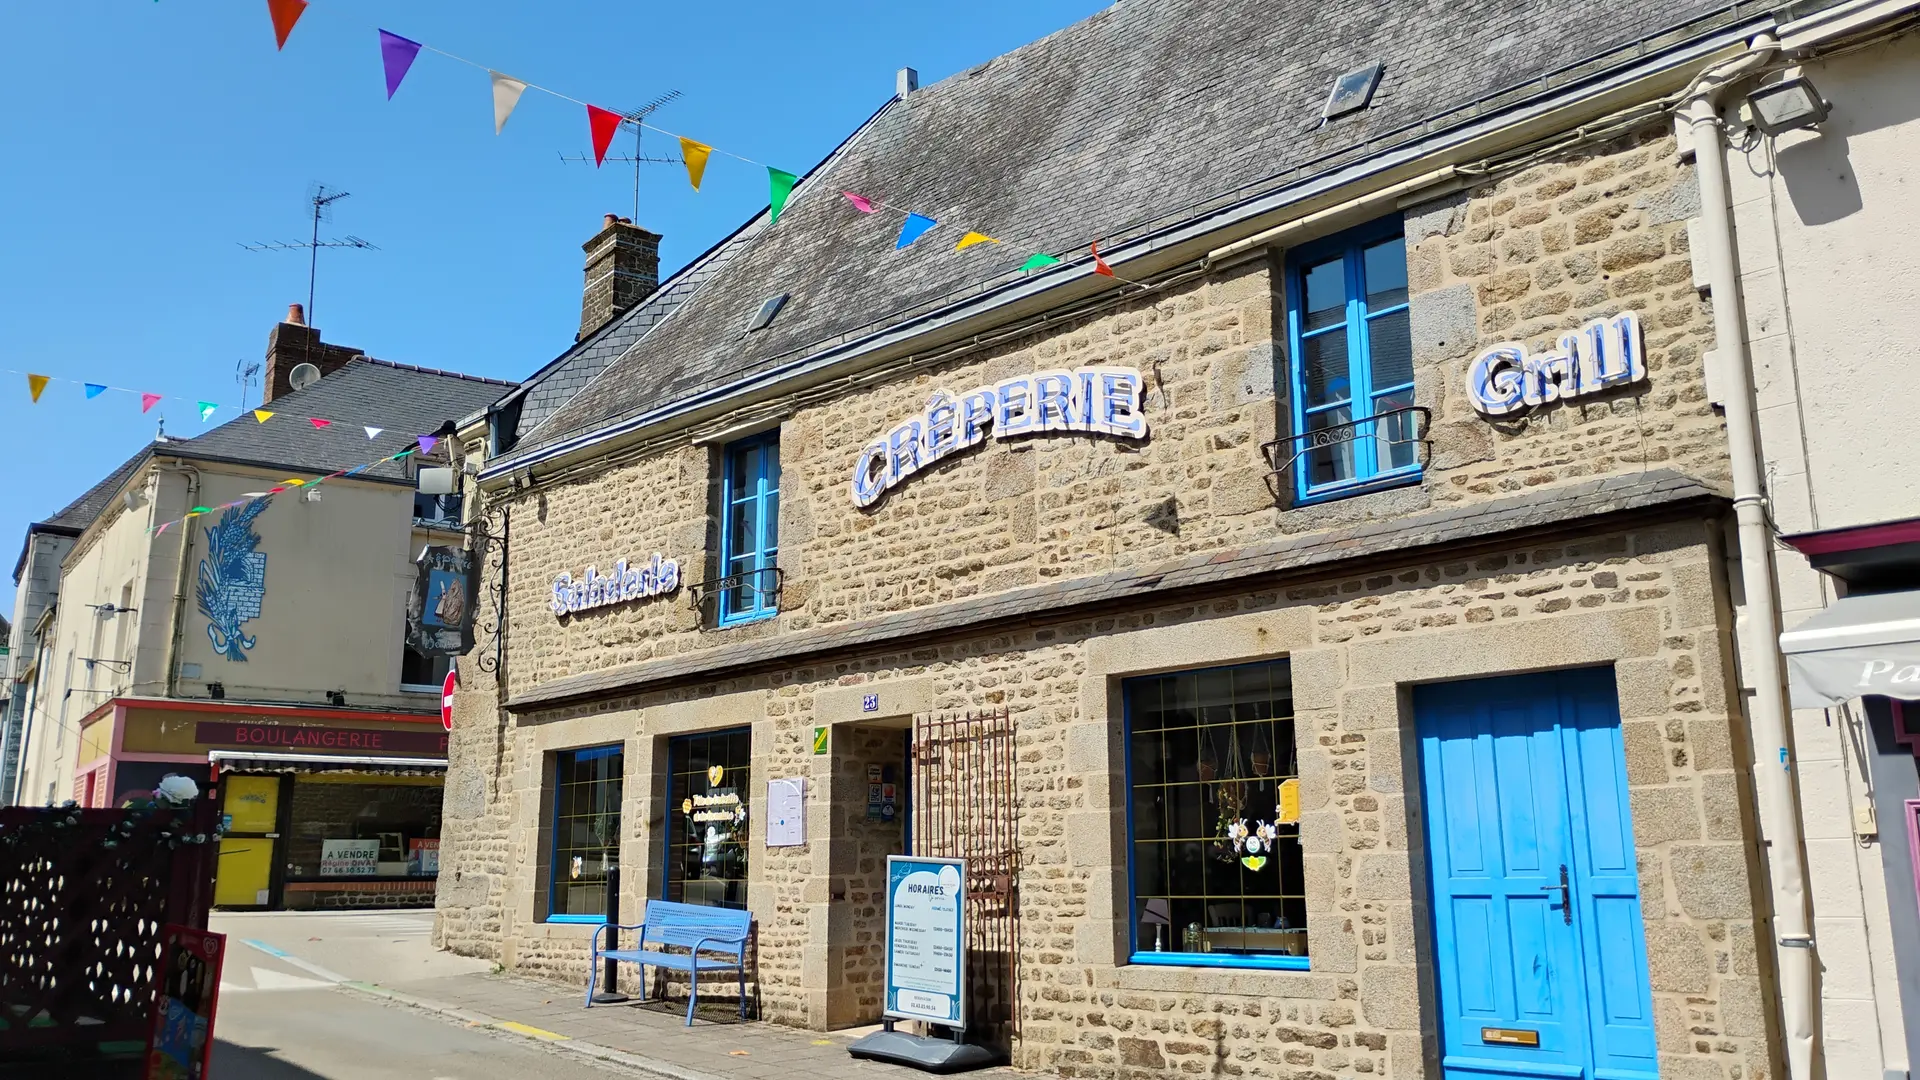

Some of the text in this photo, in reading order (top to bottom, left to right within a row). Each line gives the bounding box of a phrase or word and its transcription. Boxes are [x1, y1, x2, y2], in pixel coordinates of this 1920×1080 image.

[1468, 312, 1643, 412] Grill
[852, 369, 1145, 506] CRÊPERIE
[864, 695, 876, 710] 23
[236, 727, 383, 748] BOULANGERIE
[328, 851, 374, 859] A VENDRE
[908, 883, 944, 895] HORAIRES
